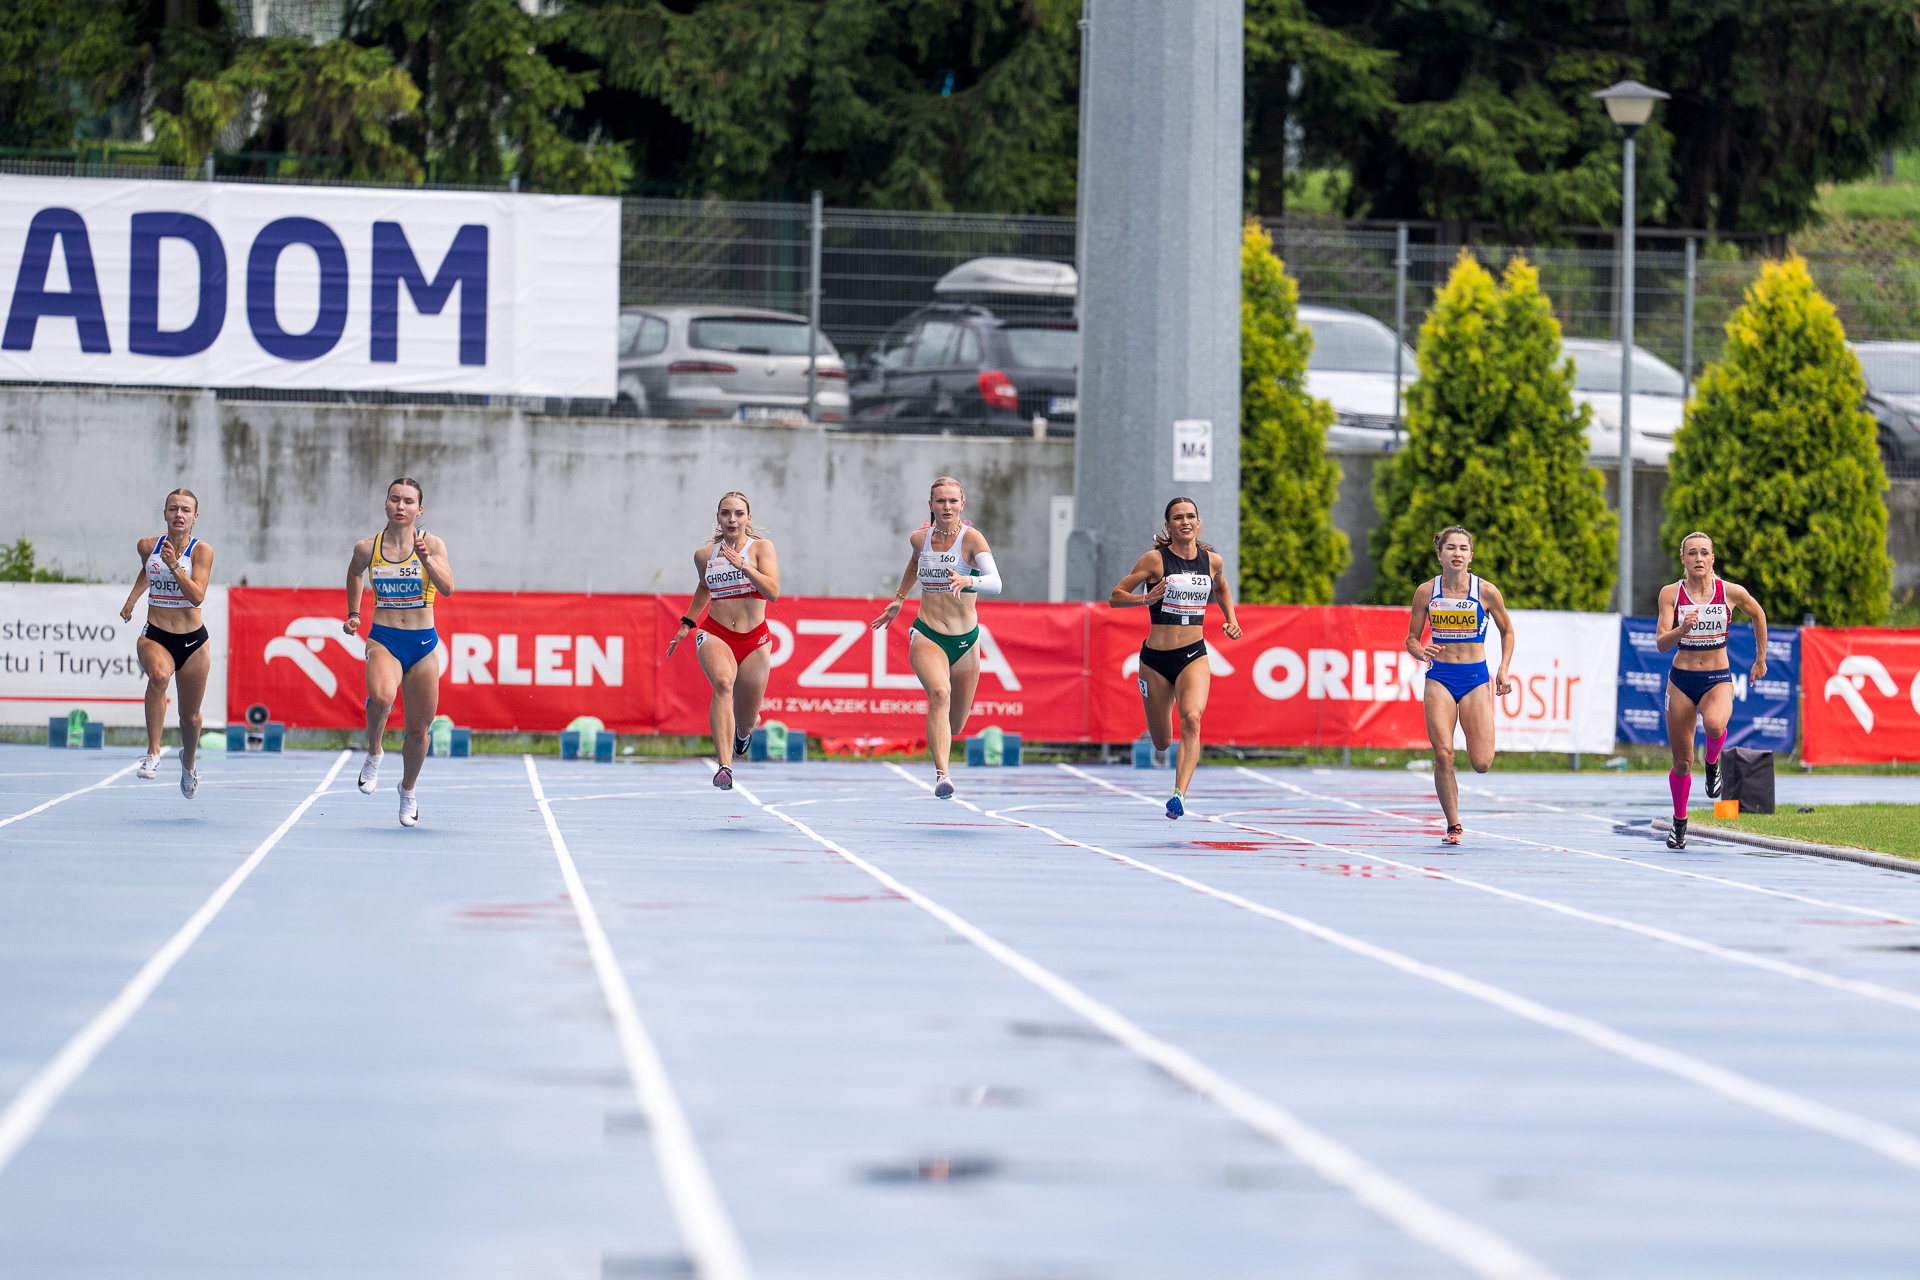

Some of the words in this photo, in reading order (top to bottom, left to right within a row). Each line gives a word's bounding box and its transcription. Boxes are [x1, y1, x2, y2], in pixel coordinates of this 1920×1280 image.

[1, 206, 490, 368] ADOM
[940, 554, 956, 563] 160
[399, 567, 418, 577] 554
[918, 568, 954, 578] ADAMCZEWS
[1191, 577, 1208, 586] 521
[375, 582, 420, 594] KANICKA
[1166, 588, 1207, 601] ŻUKOWSKA
[1456, 601, 1474, 609] 487
[1705, 606, 1723, 615] 645
[1431, 614, 1475, 626] ZIMOLĄG
[1691, 620, 1722, 630] UDZIA
[1, 619, 116, 642] sterstwo
[697, 633, 704, 646] 5
[40, 651, 44, 673] i
[1252, 646, 1427, 702] ORLEN
[1139, 680, 1146, 695] 3
[785, 698, 867, 715] ZWIĄZEK
